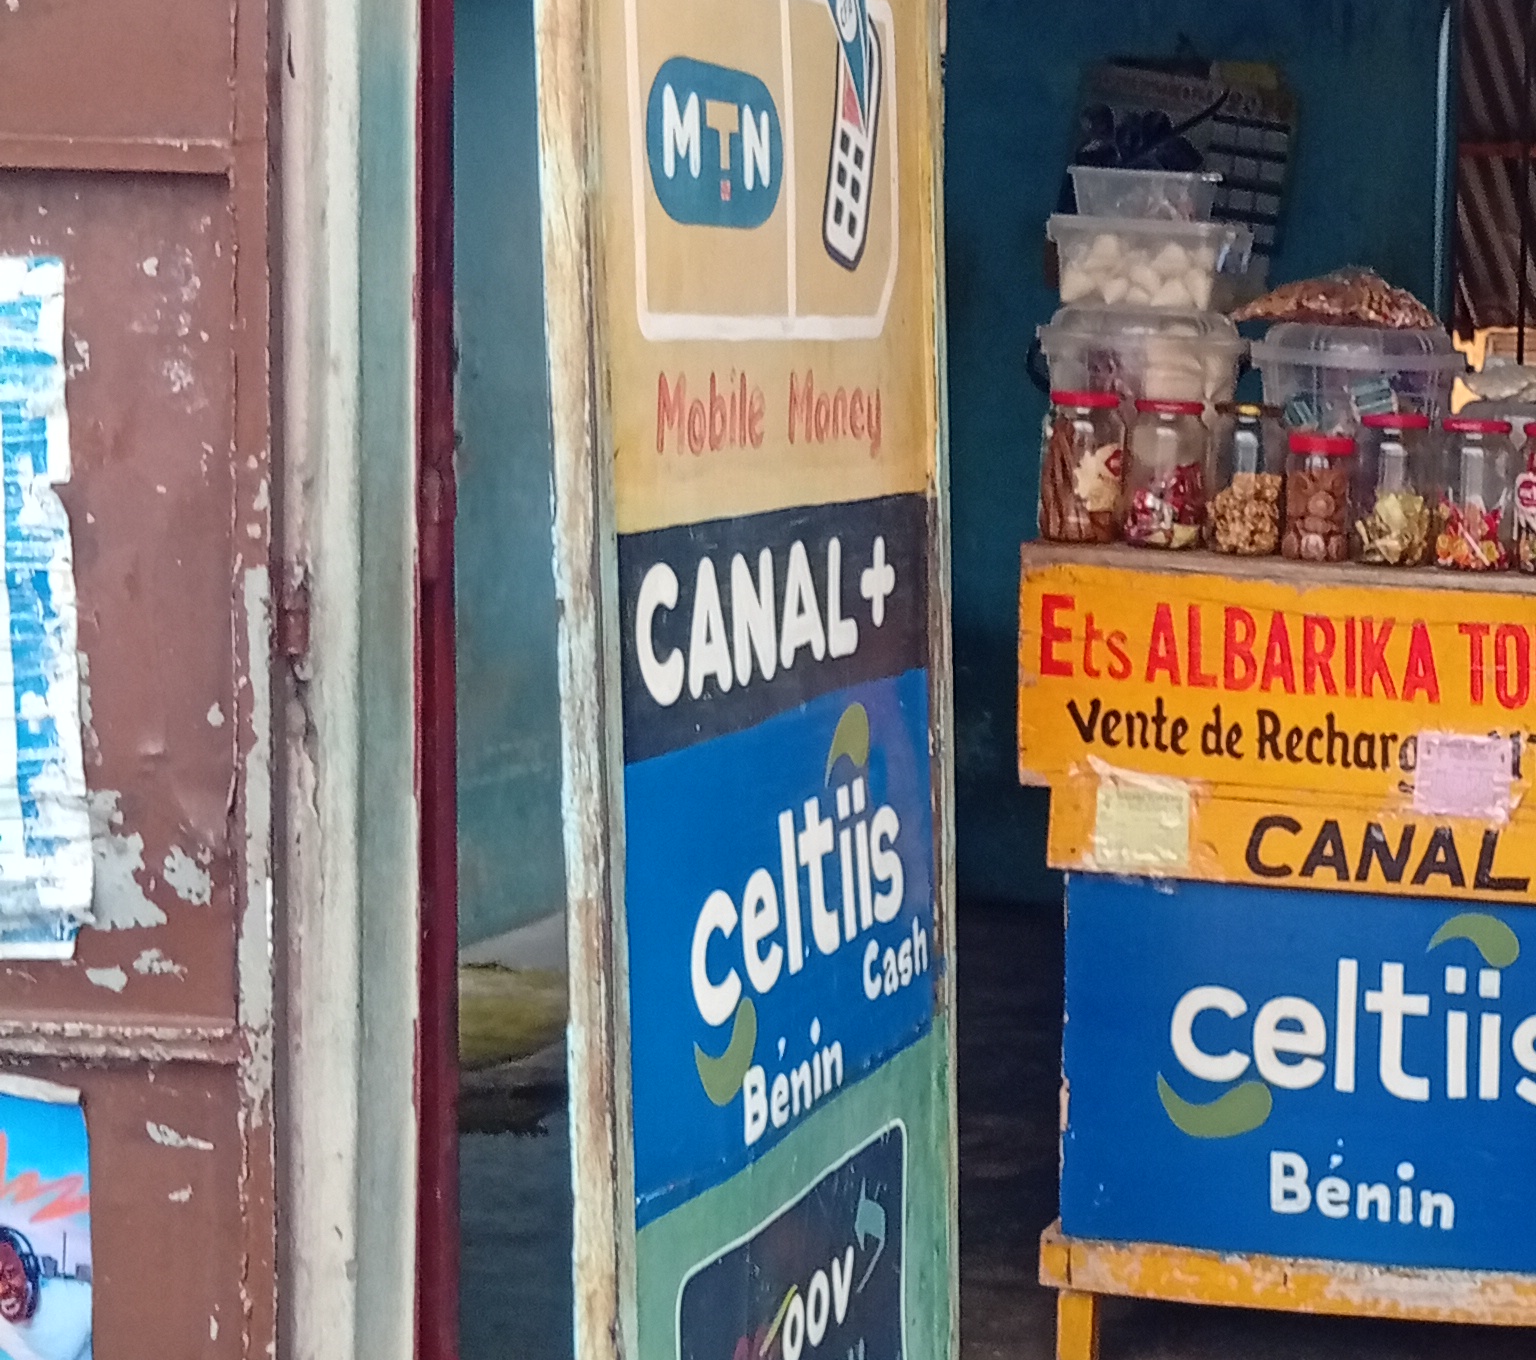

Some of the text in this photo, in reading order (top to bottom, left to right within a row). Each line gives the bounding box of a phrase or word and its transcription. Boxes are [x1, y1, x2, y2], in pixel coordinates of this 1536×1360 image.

[662, 82, 771, 191] MTN
[656, 367, 883, 458] Mobile Money
[636, 535, 896, 706] CANAL+
[1039, 592, 1132, 682] Ets
[1144, 601, 1440, 704] ALBARIKA
[1065, 697, 1190, 756] Vente
[1200, 704, 1244, 759] de
[1256, 708, 1419, 794] Recharg
[690, 777, 905, 1027] celtiis
[862, 915, 929, 1001] Cash
[742, 1016, 844, 1147] Bénin
[1269, 1144, 1456, 1231] Bénin
